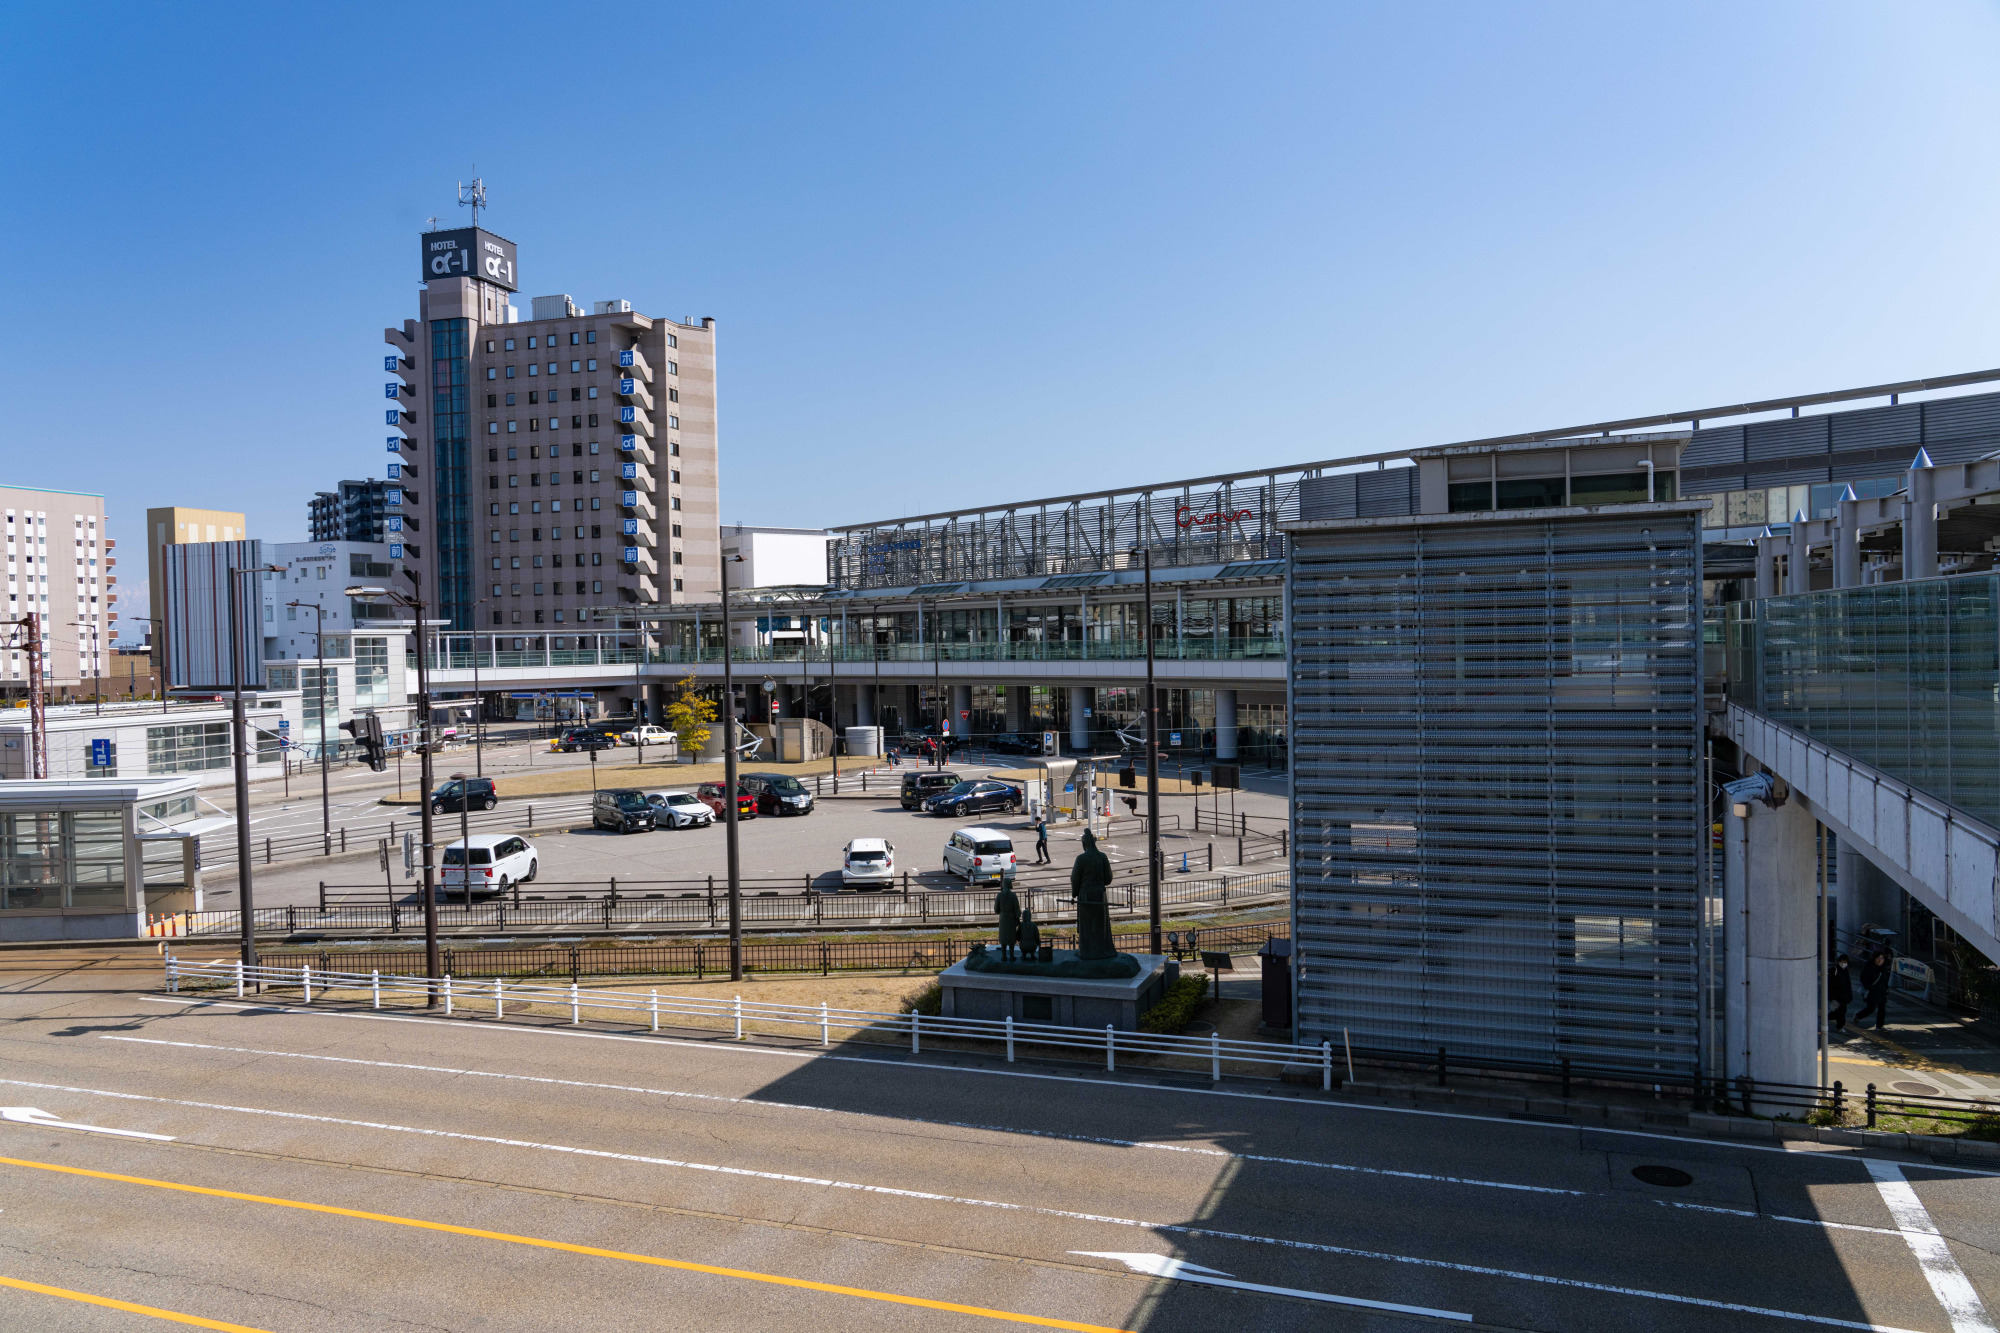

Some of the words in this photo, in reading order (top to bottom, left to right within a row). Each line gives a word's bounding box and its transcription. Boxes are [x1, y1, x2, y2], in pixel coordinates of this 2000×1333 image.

[430, 240, 458, 251] HOTEL
[484, 241, 504, 257] HOTEL
[1045, 733, 1052, 744] P
